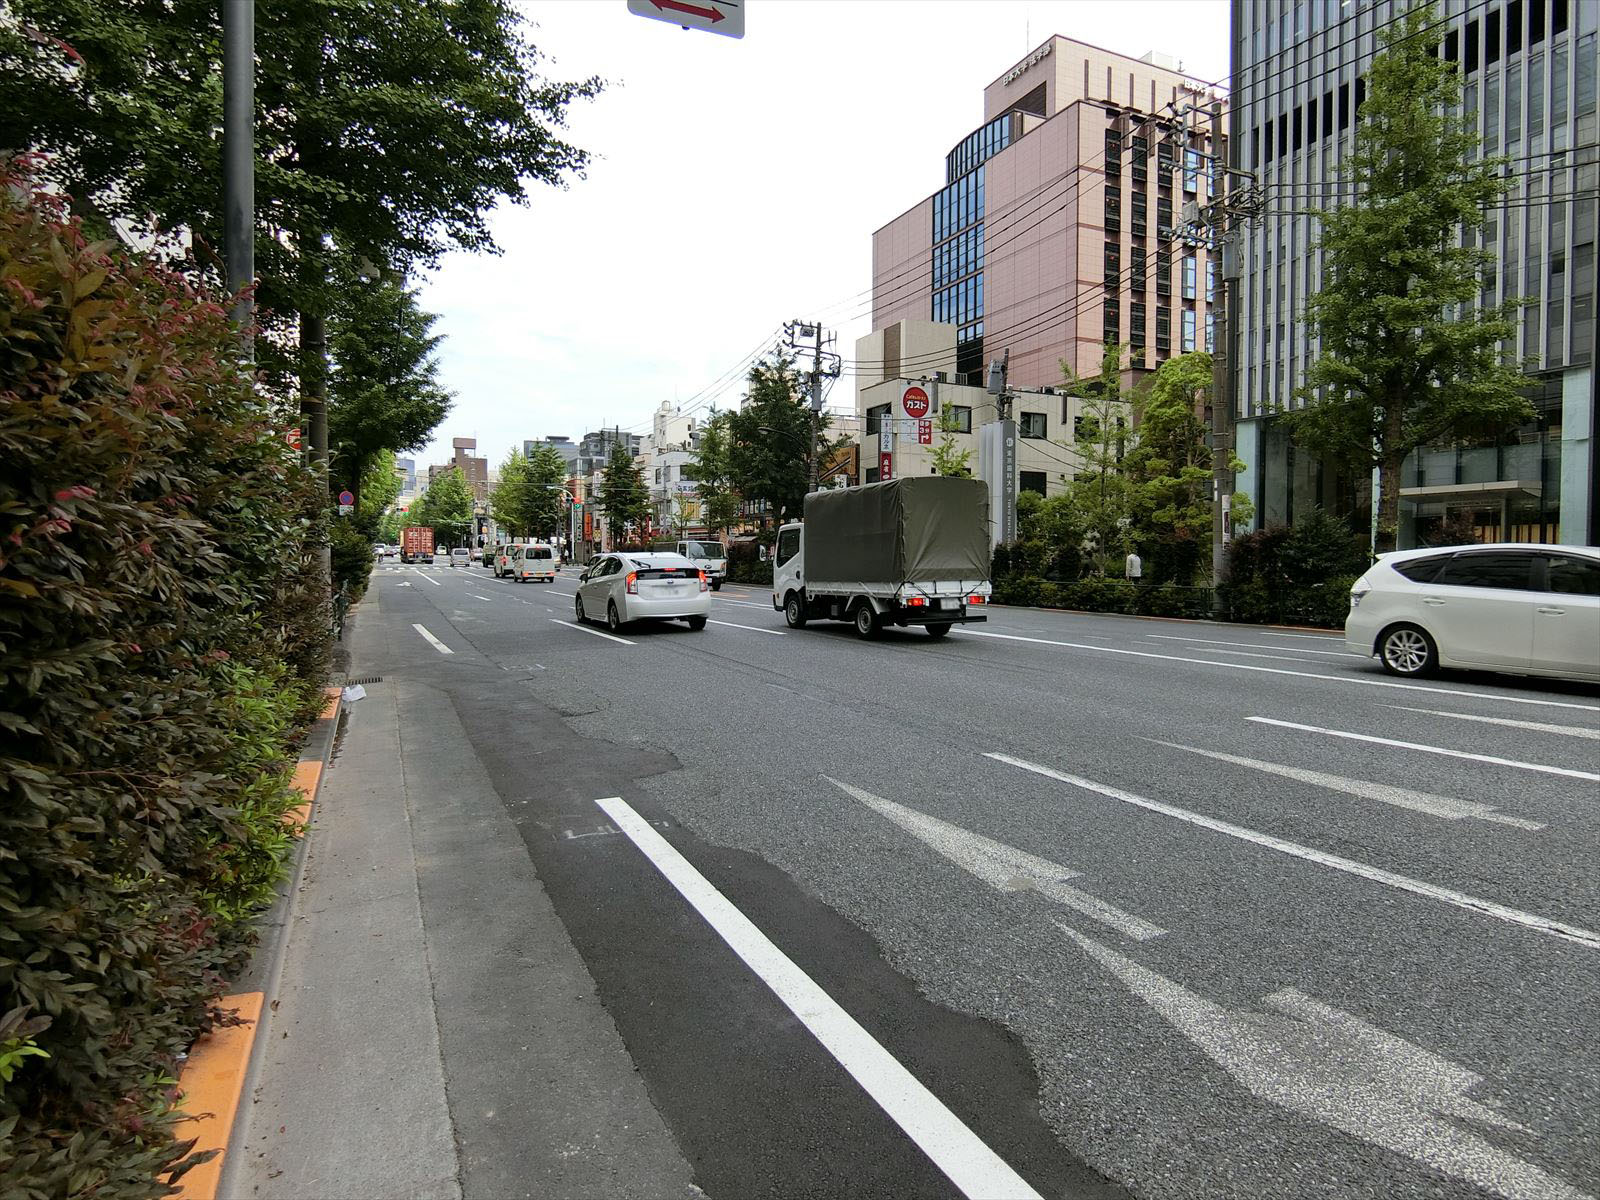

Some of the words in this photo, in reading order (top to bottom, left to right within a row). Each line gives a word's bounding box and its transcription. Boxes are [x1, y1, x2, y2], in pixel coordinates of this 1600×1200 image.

[1003, 44, 1051, 87] 日本大学法学部
[906, 400, 927, 410] ガスト
